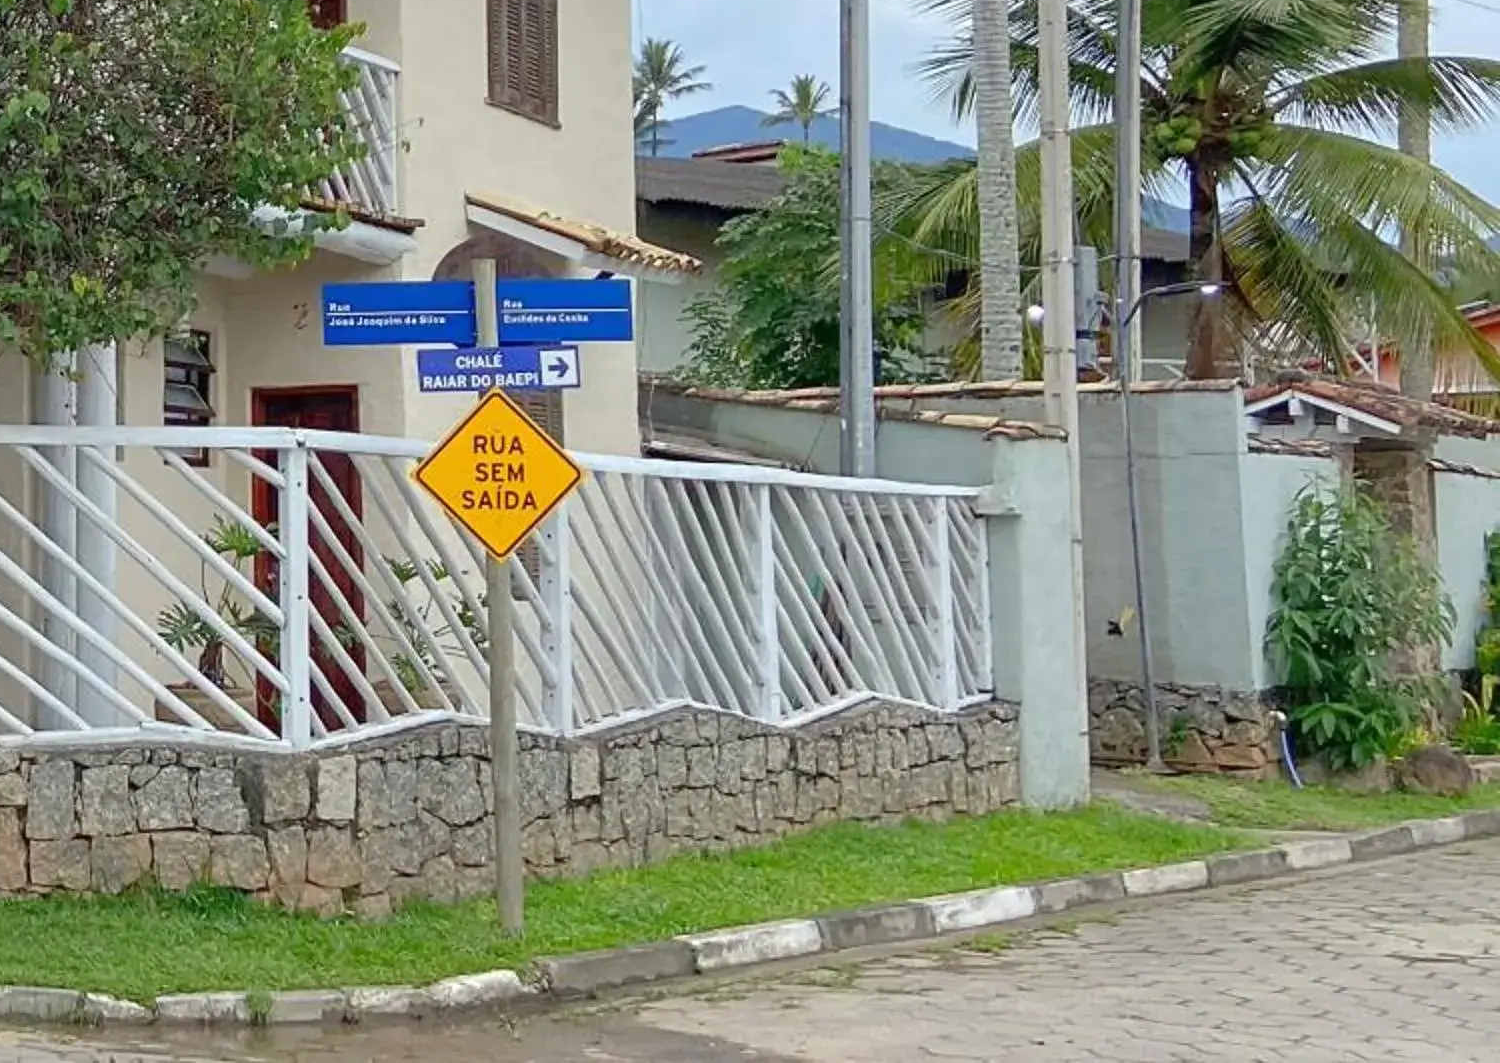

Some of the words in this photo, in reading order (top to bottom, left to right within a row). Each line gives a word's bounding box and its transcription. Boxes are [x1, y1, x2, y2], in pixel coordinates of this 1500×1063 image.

[329, 303, 350, 312] Rua
[504, 300, 523, 308] Rua
[357, 316, 402, 328] Joaquim
[419, 314, 445, 324] Silva
[558, 312, 589, 322] Cunha
[455, 350, 504, 369] CHALÉ
[423, 375, 467, 388] RAIAR
[471, 374, 491, 387] DO
[495, 372, 539, 386] BAEPI
[473, 435, 525, 455] RUA
[475, 462, 525, 483] SEM
[461, 485, 538, 510] SAÍDA
